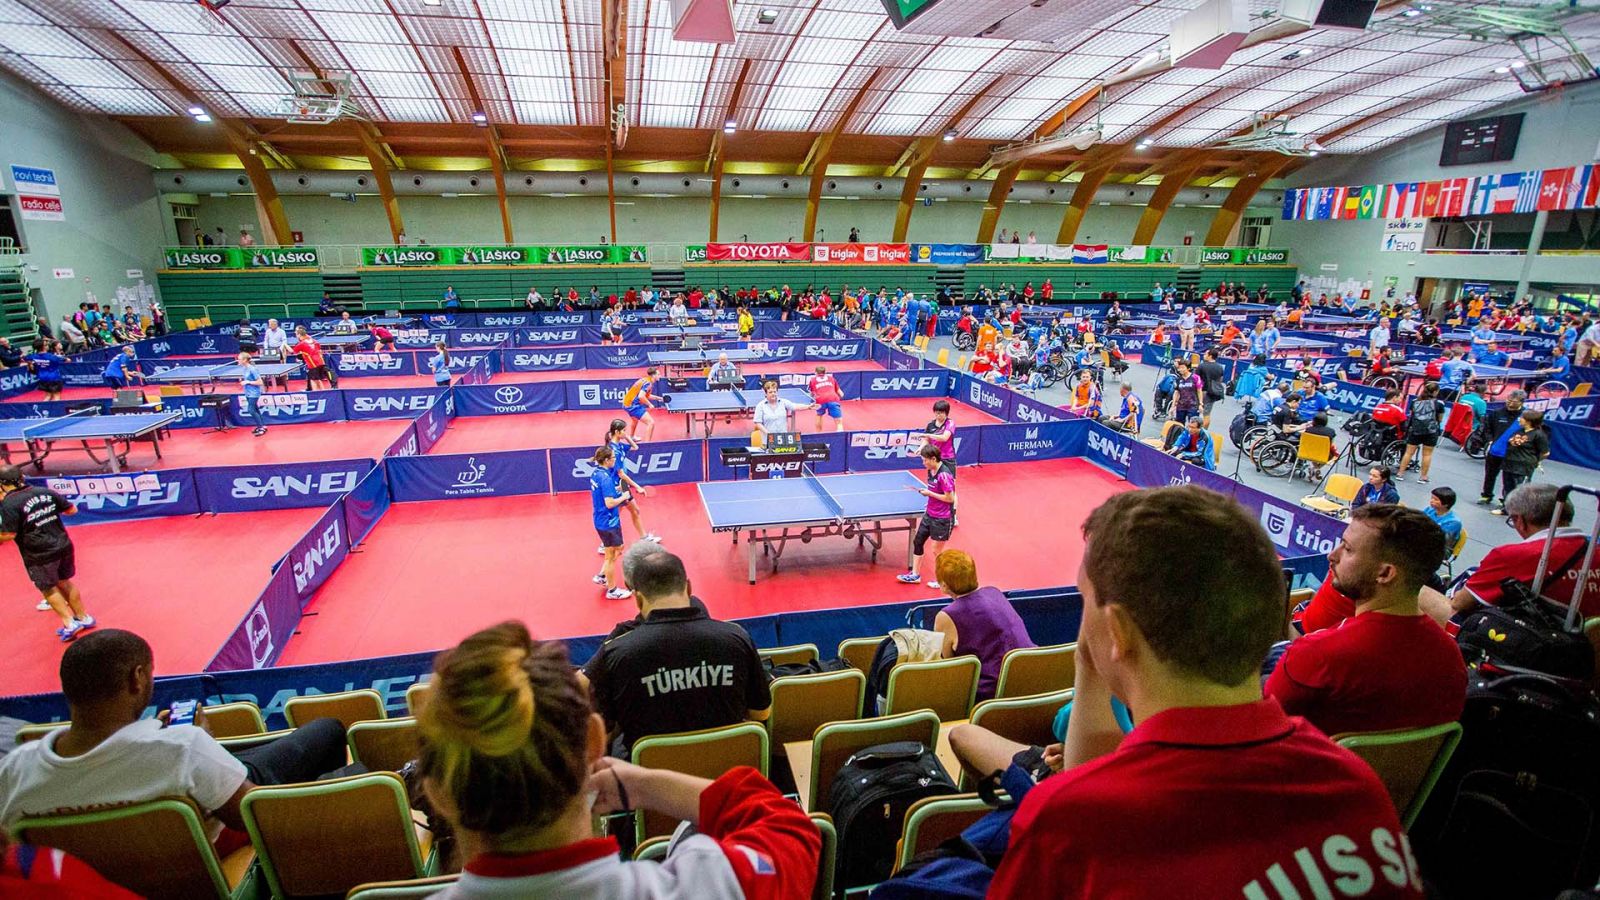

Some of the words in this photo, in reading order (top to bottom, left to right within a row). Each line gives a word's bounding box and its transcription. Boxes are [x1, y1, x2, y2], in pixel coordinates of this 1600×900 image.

[729, 245, 789, 257] TOYOTA
[831, 249, 858, 260] triglav
[880, 249, 906, 260] triglav
[484, 316, 526, 326] SAN-EI
[543, 315, 584, 324] SAN-EI
[460, 332, 509, 343] SAN-EI
[528, 331, 577, 341] SAN-EI
[804, 344, 858, 356] SAN-EI
[513, 353, 574, 366] SAN-EI
[871, 376, 939, 391] SAN-EI
[603, 387, 628, 403] trig
[981, 389, 1003, 408] triglav
[353, 394, 435, 412] SAN-EI
[493, 405, 527, 413] TOYOTA
[777, 435, 783, 444] 5
[1008, 440, 1053, 450] THERMANA
[572, 452, 683, 478] SN-EI
[755, 461, 801, 472] SAN-EI
[231, 471, 357, 499] SAN-EI
[66, 481, 180, 510] AN-EI
[293, 518, 341, 594] SAN-EI
[641, 660, 734, 697] TÜRKİYE
